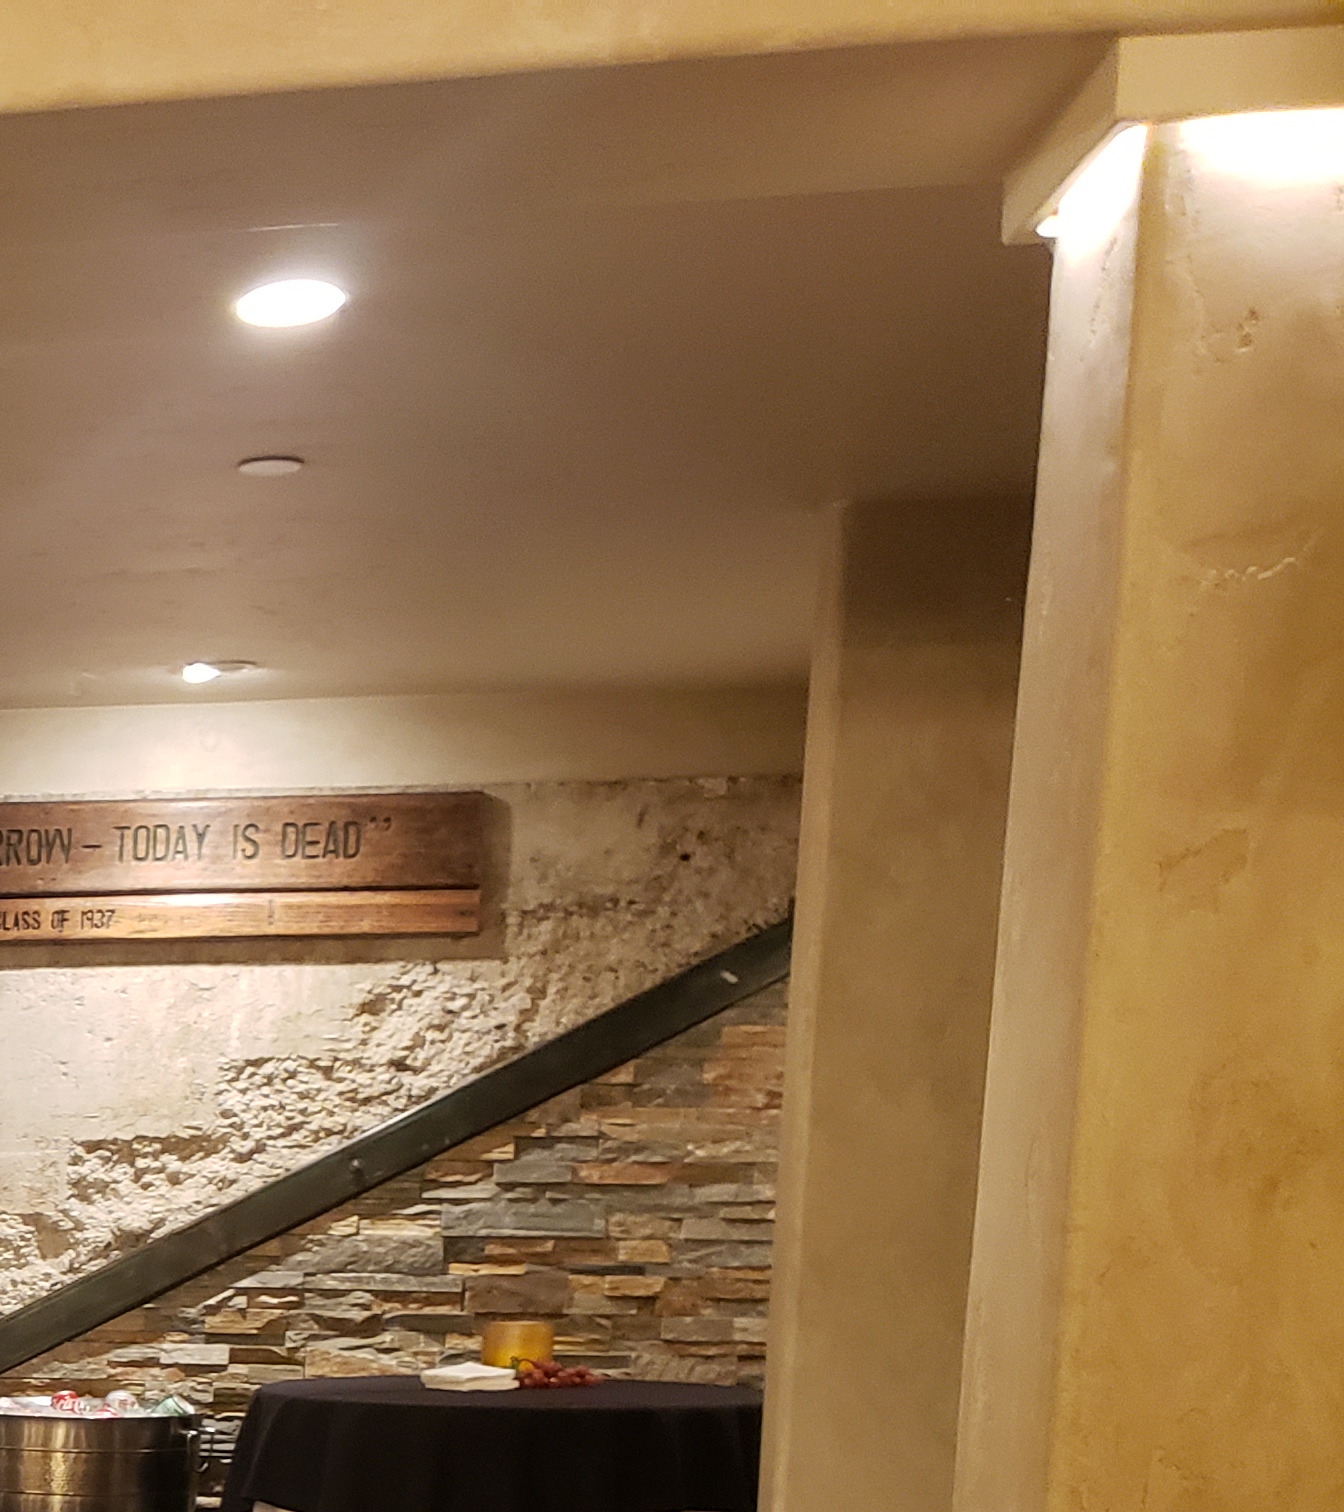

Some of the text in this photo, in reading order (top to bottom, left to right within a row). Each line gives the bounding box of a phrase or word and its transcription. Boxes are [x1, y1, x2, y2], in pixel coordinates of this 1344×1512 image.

[232, 822, 261, 861] IS
[50, 910, 70, 932] OF
[80, 908, 116, 930] 1937
